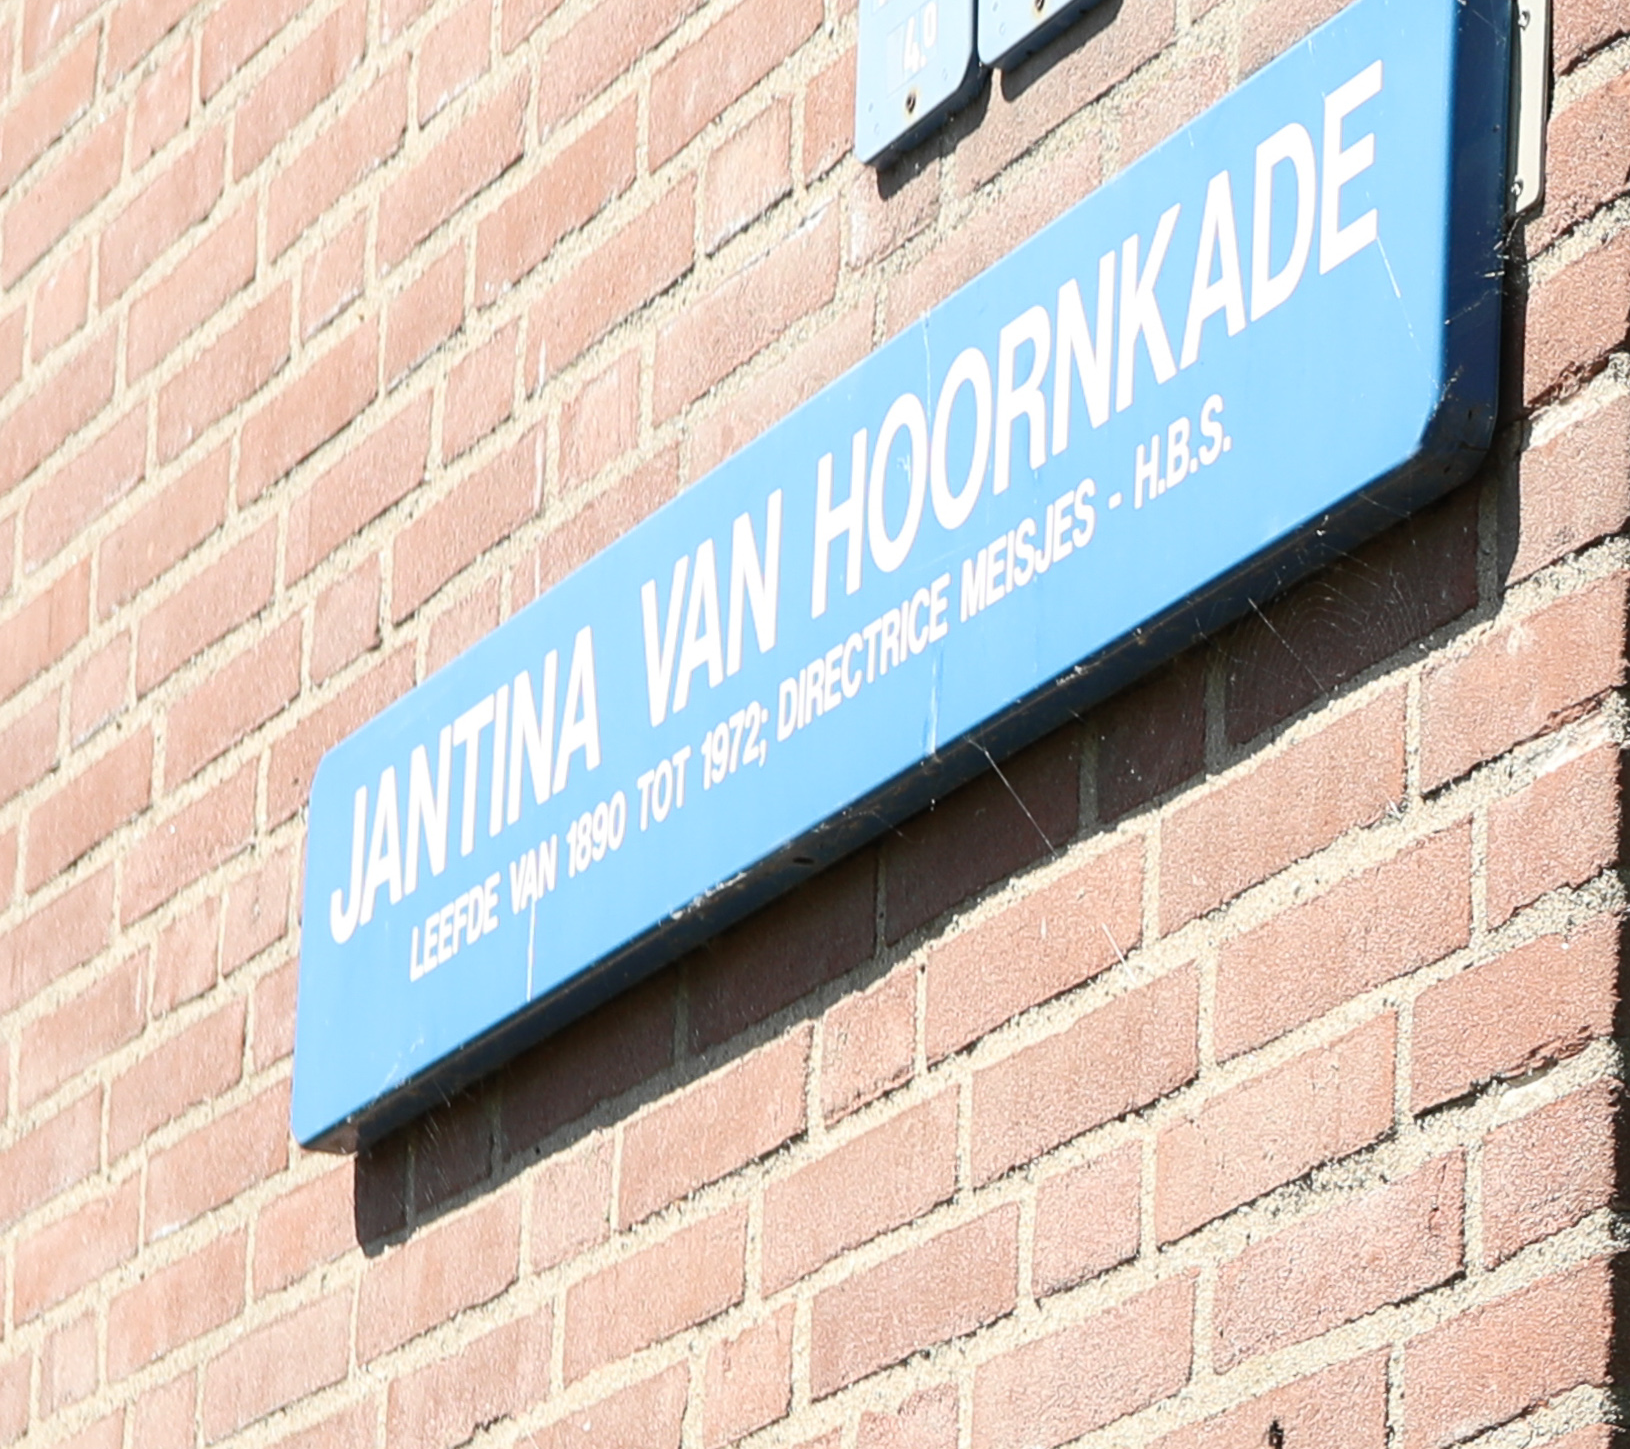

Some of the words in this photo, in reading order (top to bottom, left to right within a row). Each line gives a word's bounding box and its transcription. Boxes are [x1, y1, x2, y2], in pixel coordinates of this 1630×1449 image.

[329, 627, 598, 943] JANTINA
[641, 490, 782, 727] VAN
[811, 60, 1383, 616] HOORNKADE
[409, 872, 501, 983] LEEFDE
[509, 835, 558, 914] VAN
[565, 791, 626, 876] 1890
[636, 745, 690, 831] TOT
[700, 700, 771, 789] 1972;
[776, 574, 950, 742] DIRECTRICE
[959, 479, 1097, 621] MEISJES
[1134, 395, 1231, 507] H.B.S.
